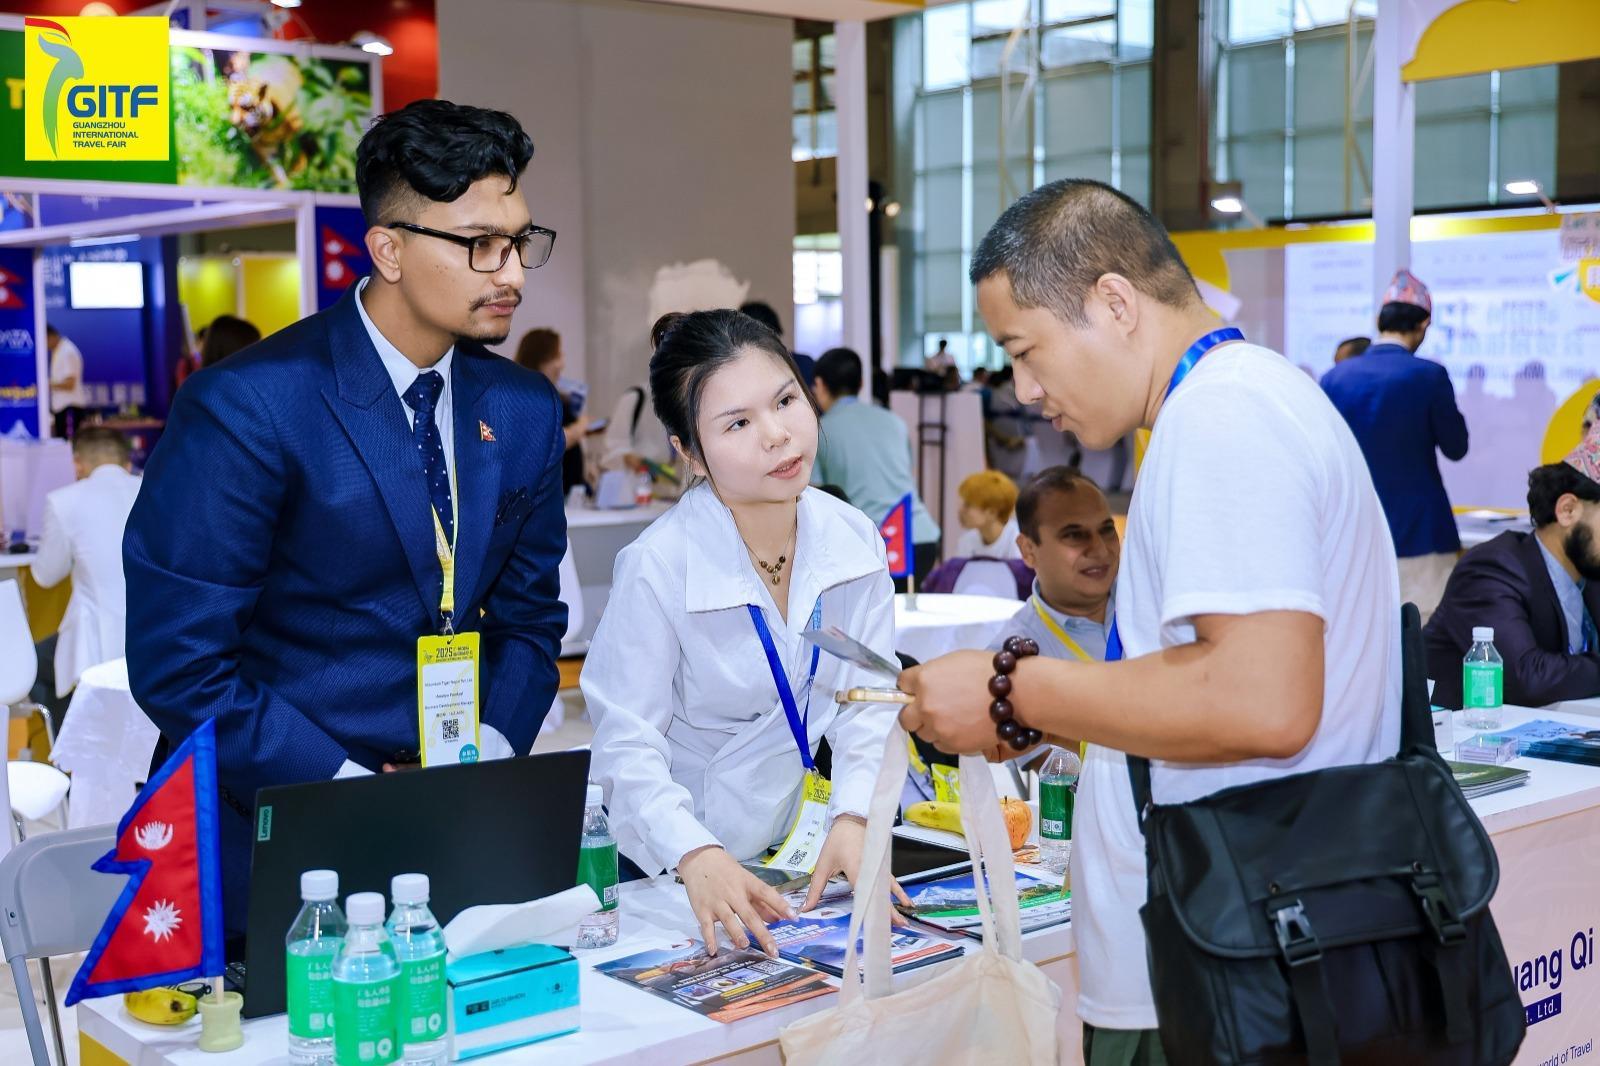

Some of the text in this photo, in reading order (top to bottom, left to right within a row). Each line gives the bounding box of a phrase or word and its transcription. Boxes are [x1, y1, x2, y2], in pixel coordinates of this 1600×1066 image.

[436, 646, 453, 658] 2025
[261, 808, 270, 838] Lenovo
[1570, 927, 1594, 971] Qi
[1537, 998, 1558, 1019] Ltd.
[1561, 1048, 1569, 1064] of
[1570, 1037, 1593, 1060] Travel
